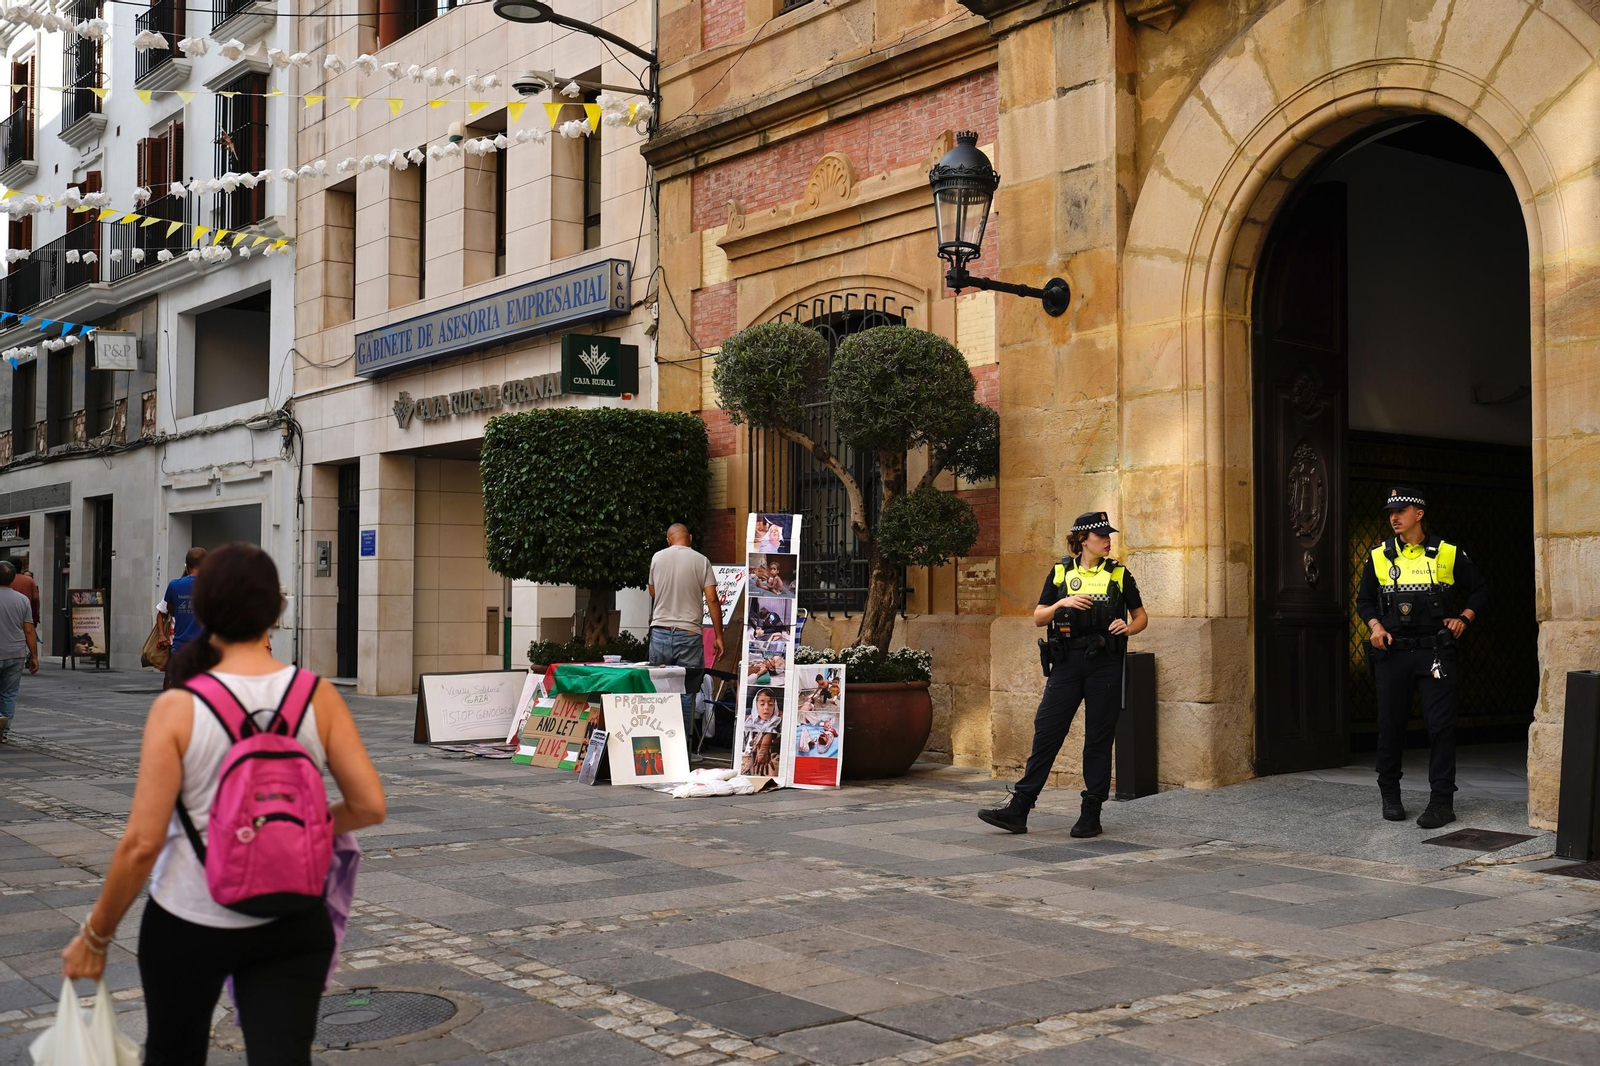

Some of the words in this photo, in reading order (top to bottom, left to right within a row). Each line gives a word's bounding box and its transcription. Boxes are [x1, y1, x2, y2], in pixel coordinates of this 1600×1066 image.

[357, 328, 413, 366] GABINETE
[417, 323, 434, 350] DE
[438, 303, 500, 344] ASESORIA
[506, 274, 607, 326] EMPRESARIAL
[103, 343, 131, 358] P&P
[573, 376, 590, 385] CAJA
[591, 378, 616, 387] RURAL
[414, 395, 450, 421] CAJA
[448, 384, 502, 415] RURAL
[464, 694, 489, 704] GAZA
[552, 700, 583, 719] LIVE
[536, 717, 557, 733] AND
[556, 720, 578, 736] LET
[614, 715, 676, 742] FLOTILLA
[536, 738, 566, 757] LIVE
